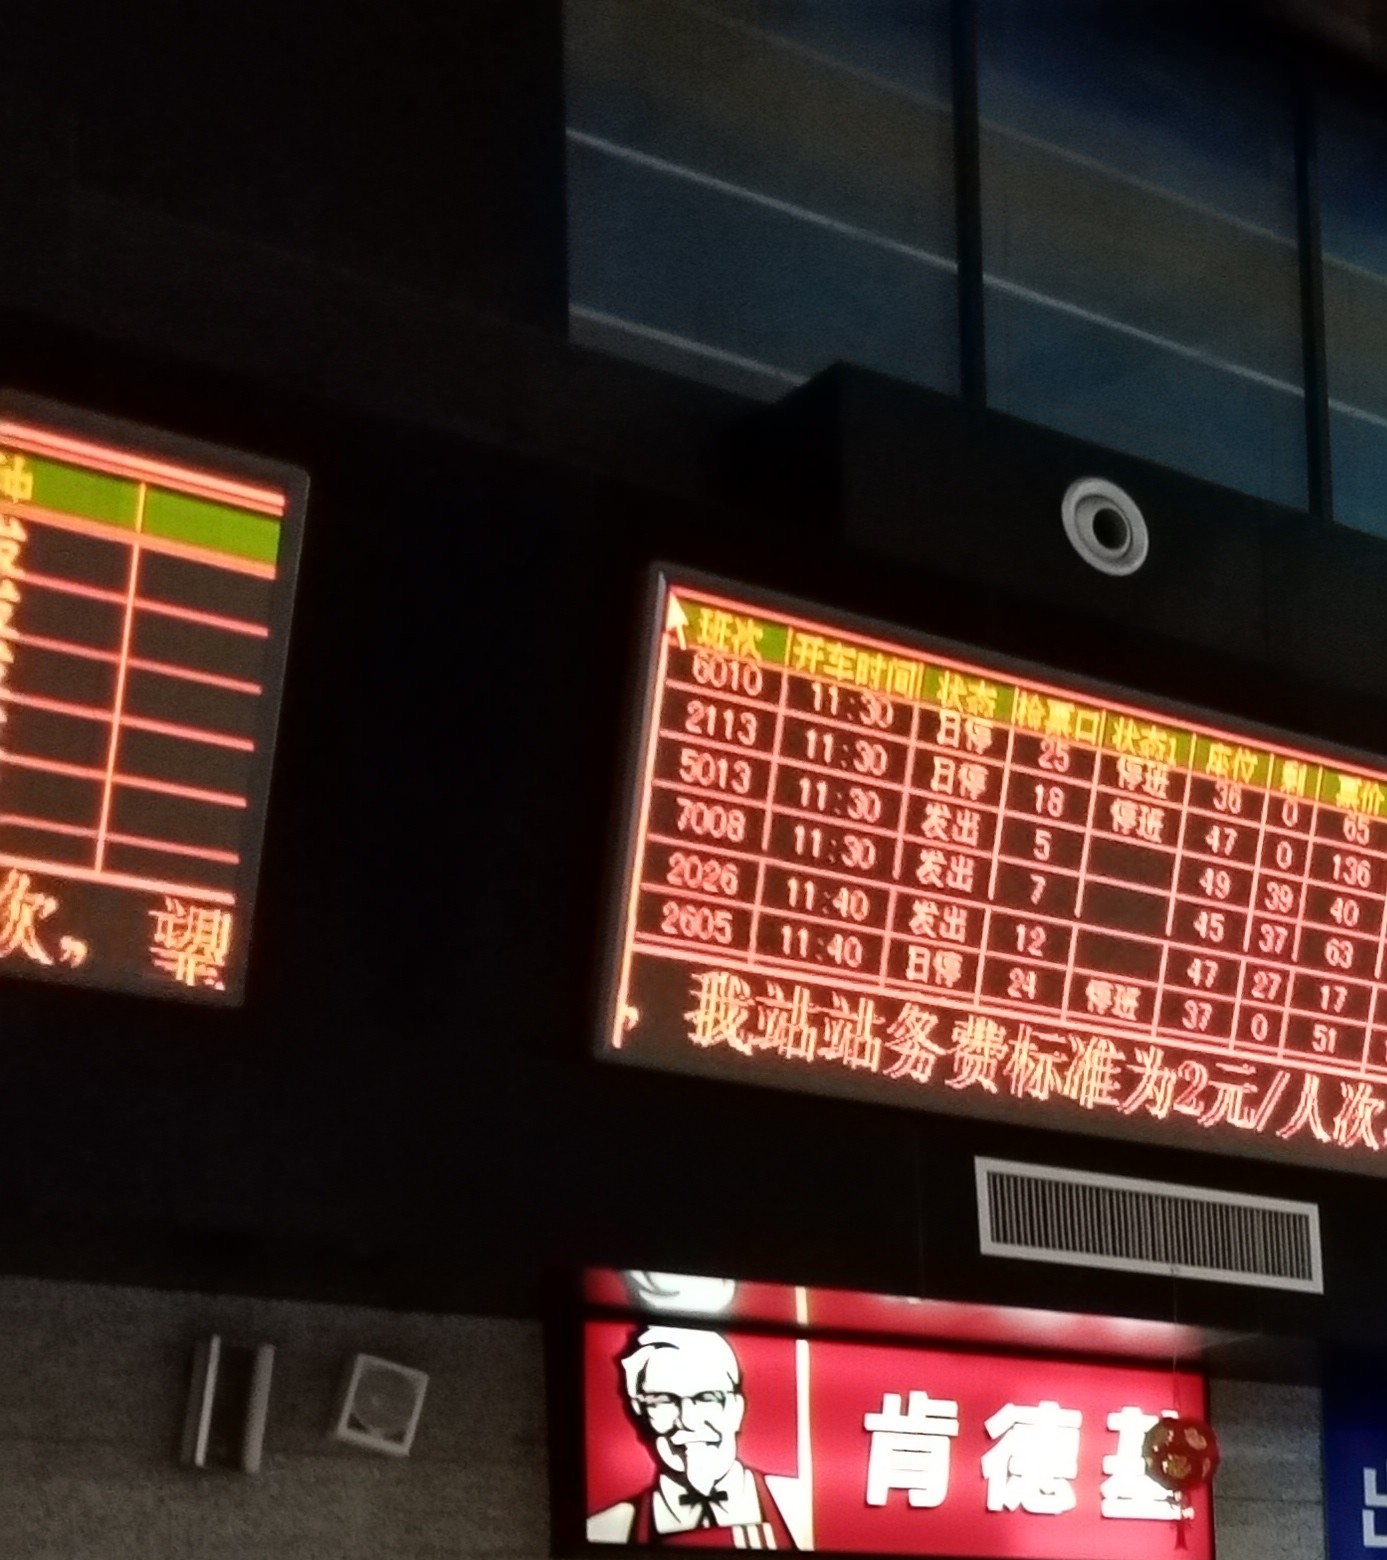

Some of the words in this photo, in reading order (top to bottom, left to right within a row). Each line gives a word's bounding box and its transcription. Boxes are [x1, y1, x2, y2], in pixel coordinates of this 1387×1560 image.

[685, 700, 756, 744] 2113
[806, 729, 887, 775] 11:30
[1035, 784, 1063, 816] 18
[1205, 825, 1237, 854] 47
[1276, 841, 1292, 869] 0
[1333, 854, 1370, 887] 136
[697, 608, 764, 657] 班次
[794, 634, 919, 701] 开车时间
[937, 671, 997, 714] 状态
[1015, 687, 1100, 740] 检票口
[1205, 743, 1258, 783] 座位
[1336, 774, 1385, 816] 票价
[677, 797, 745, 841] 7008
[795, 825, 875, 868] 11:30
[1030, 874, 1045, 903] 7
[1193, 911, 1224, 941] 45
[1259, 923, 1287, 953] 37
[1325, 938, 1353, 968] 63
[679, 748, 750, 793] 5013
[799, 778, 880, 822] 11:30
[1034, 829, 1050, 859] 5
[1199, 867, 1230, 898] 49
[1265, 881, 1293, 912] 39
[1330, 897, 1359, 926] 40
[661, 901, 731, 943] 2605
[782, 925, 862, 967] 11:40
[1007, 967, 1036, 999] 24
[1182, 999, 1212, 1030] 37
[1251, 1013, 1267, 1040] 0
[1312, 1024, 1336, 1052] 51
[667, 852, 737, 894] 2026
[788, 878, 868, 920] 11:40
[1016, 923, 1045, 956] 12
[1187, 958, 1217, 987] 47
[1251, 971, 1281, 999] 27
[1321, 985, 1347, 1012] 17
